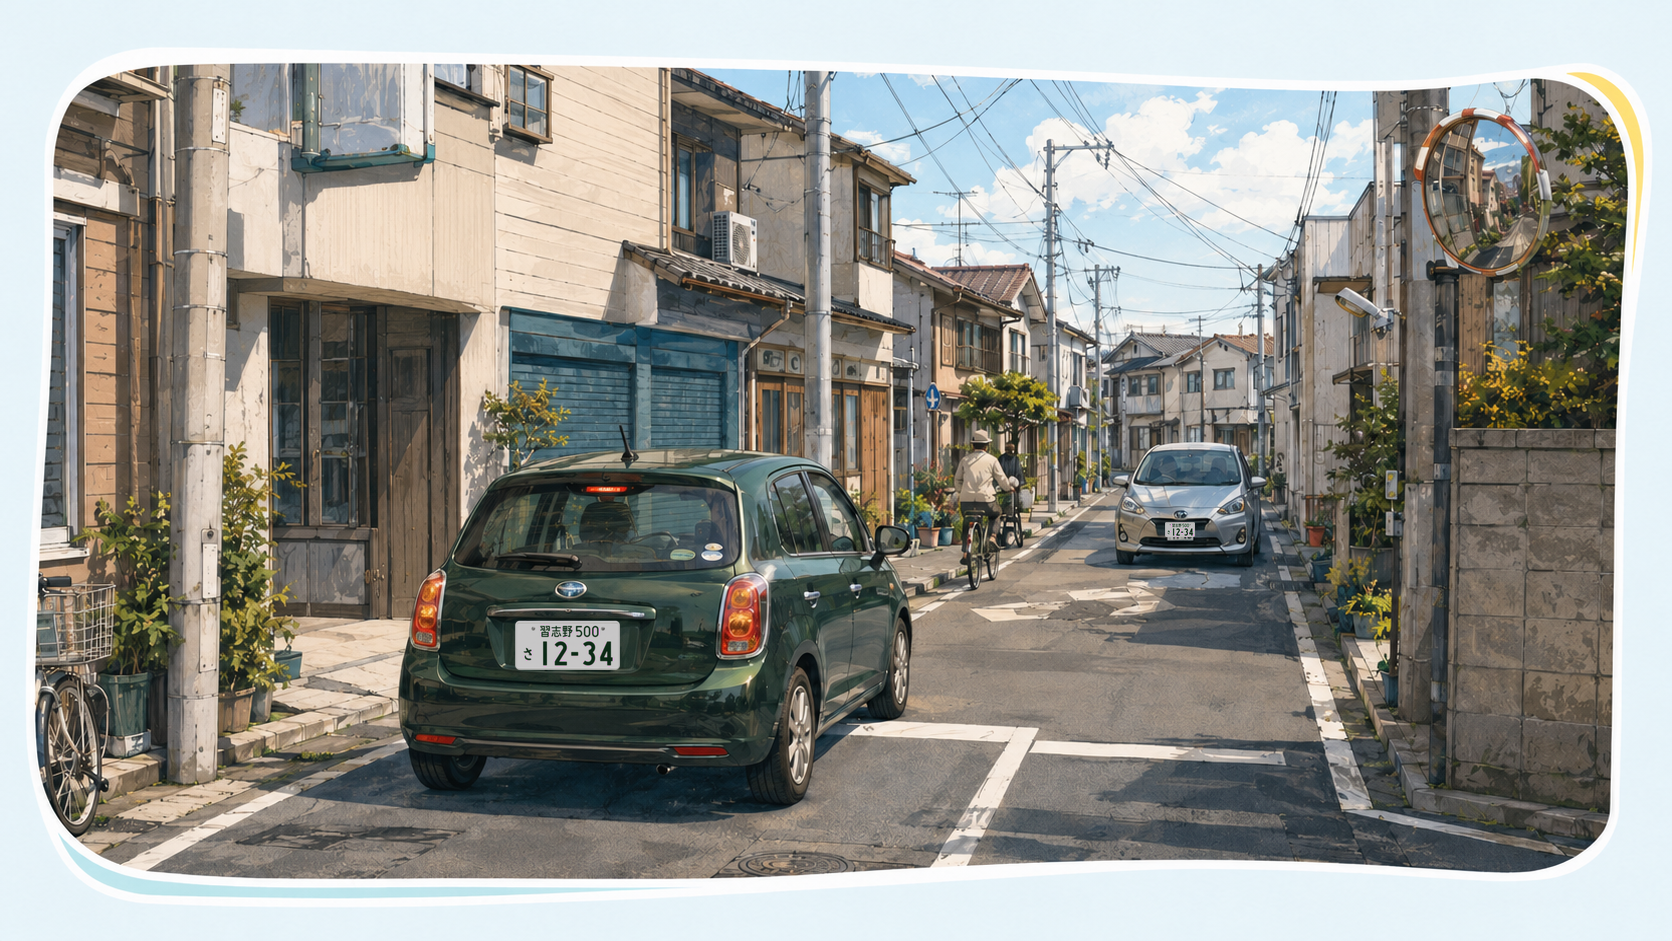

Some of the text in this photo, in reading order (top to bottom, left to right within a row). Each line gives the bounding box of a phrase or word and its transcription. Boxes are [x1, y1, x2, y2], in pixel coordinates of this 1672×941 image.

[1172, 528, 1193, 536] 12-34
[540, 625, 600, 638] 習志野 500
[523, 641, 613, 666] さ 12-34
